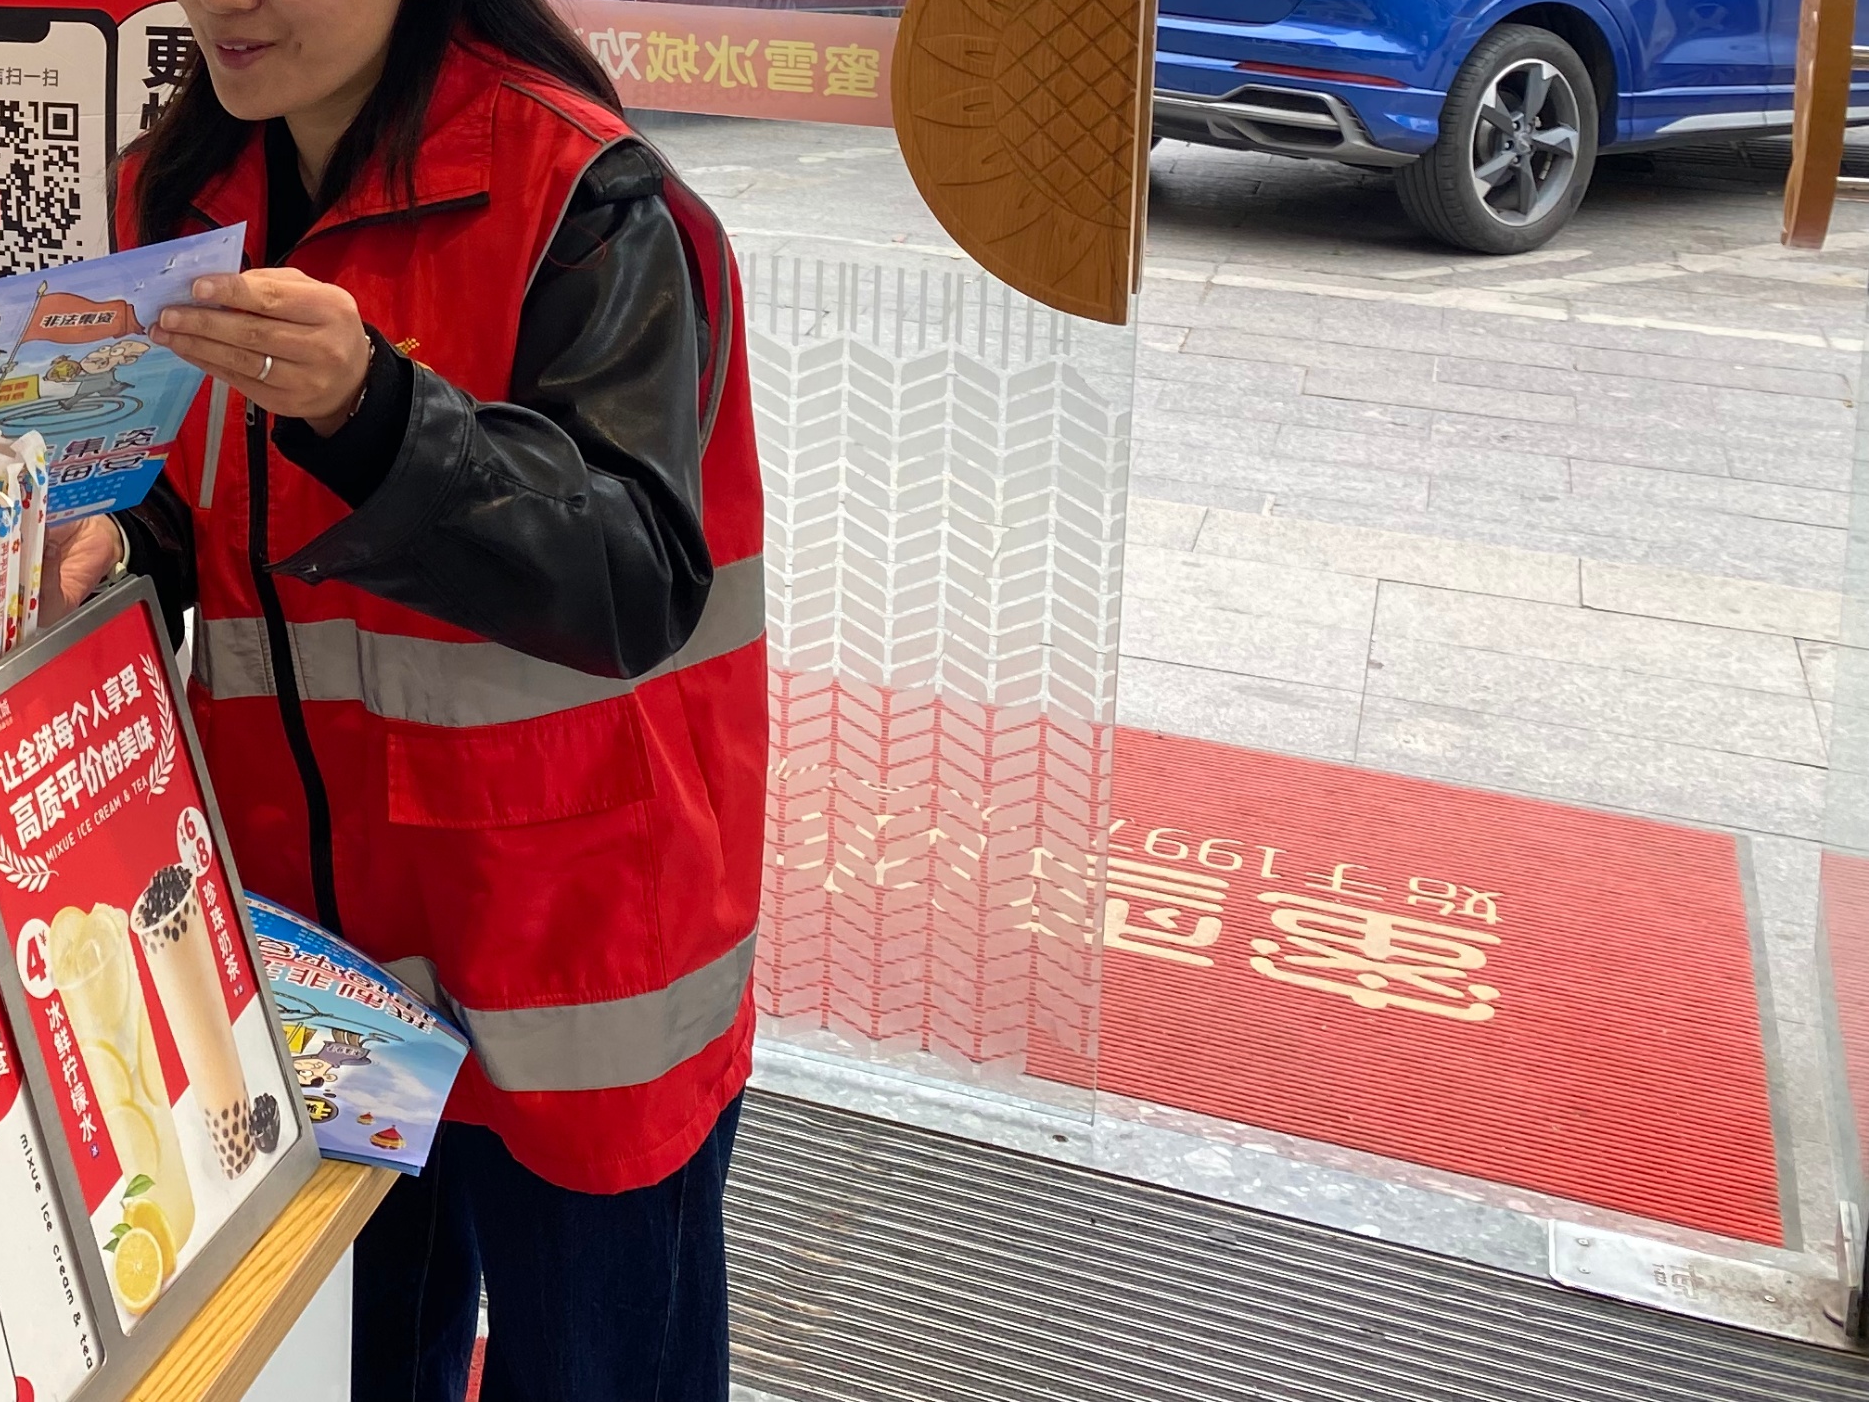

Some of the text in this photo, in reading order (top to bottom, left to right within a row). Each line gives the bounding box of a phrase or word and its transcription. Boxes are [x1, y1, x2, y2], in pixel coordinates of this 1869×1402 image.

[142, 25, 194, 88] 更
[41, 311, 117, 328] 非法集资
[9, 714, 156, 851] 高质平价的美味
[44, 775, 149, 864] MIXUE ICE CREAM & TEA
[201, 879, 241, 983] 珍珠奶茶
[45, 1000, 98, 1143] 冰鲜柠檬水
[19, 1133, 42, 1193] mixue
[40, 1202, 54, 1233] ice
[52, 1244, 74, 1305] cream
[79, 1333, 94, 1371] tea
